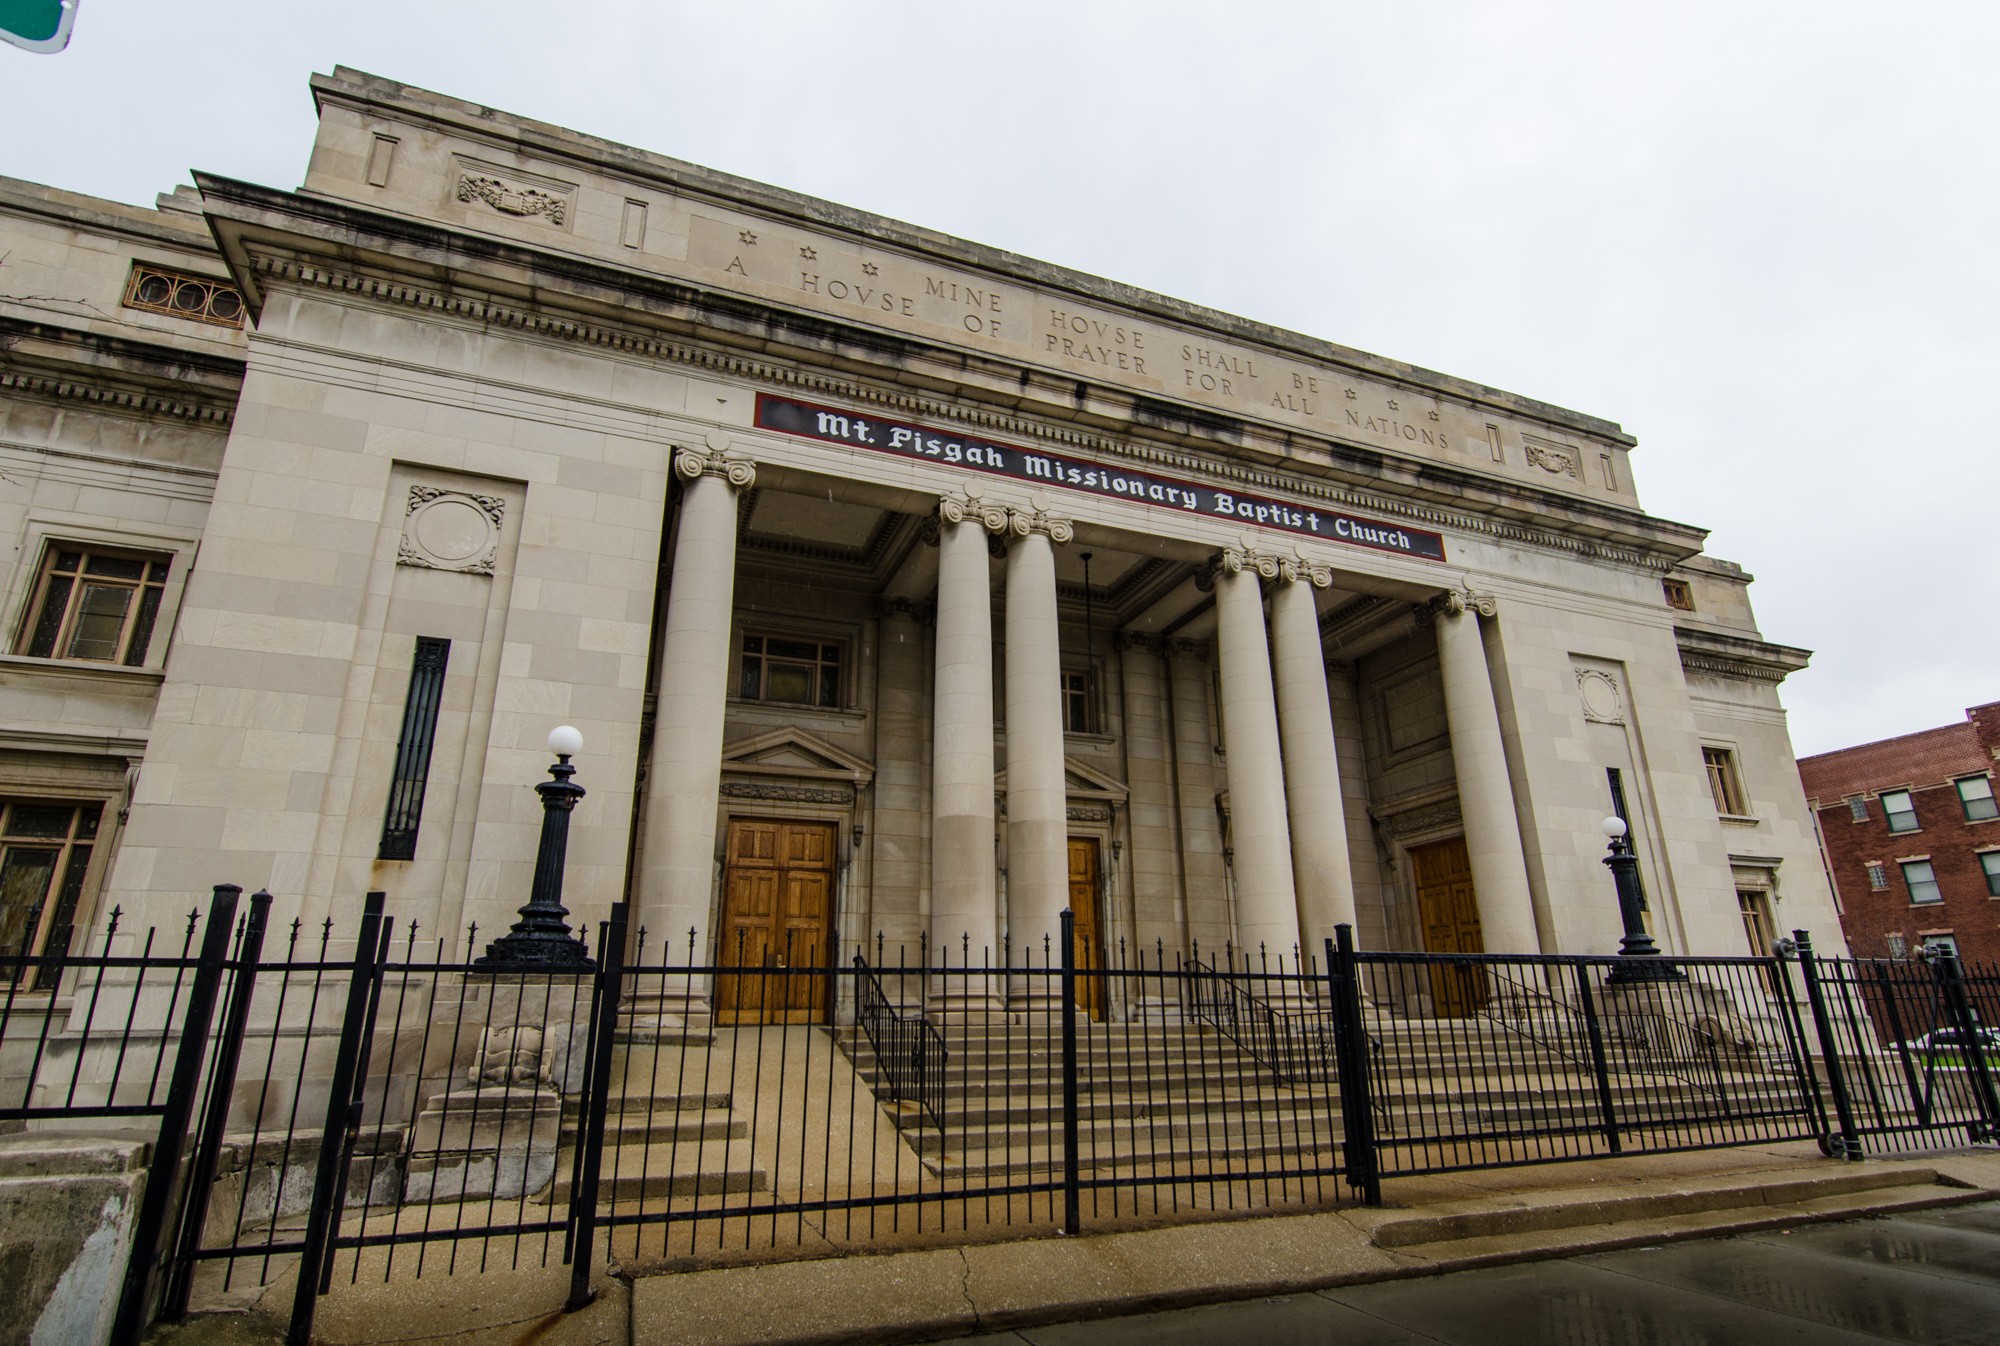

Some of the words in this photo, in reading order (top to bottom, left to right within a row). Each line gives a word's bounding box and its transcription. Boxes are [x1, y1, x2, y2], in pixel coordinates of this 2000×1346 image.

[724, 256, 748, 277] A
[963, 314, 1002, 338] OF
[1045, 334, 1147, 374] PRAYER
[1185, 369, 1234, 396] FOR
[1269, 392, 1314, 416] ALL
[1346, 409, 1449, 449] NATIONS
[925, 277, 1002, 313] MINE
[1181, 345, 1259, 378] SHALL
[1292, 373, 1319, 394] BE
[817, 412, 875, 444] Mt.
[888, 427, 1004, 468] Pisgah
[1024, 455, 1197, 510] Missionary
[1214, 492, 1319, 531] Baptist
[1335, 518, 1411, 550] Church
